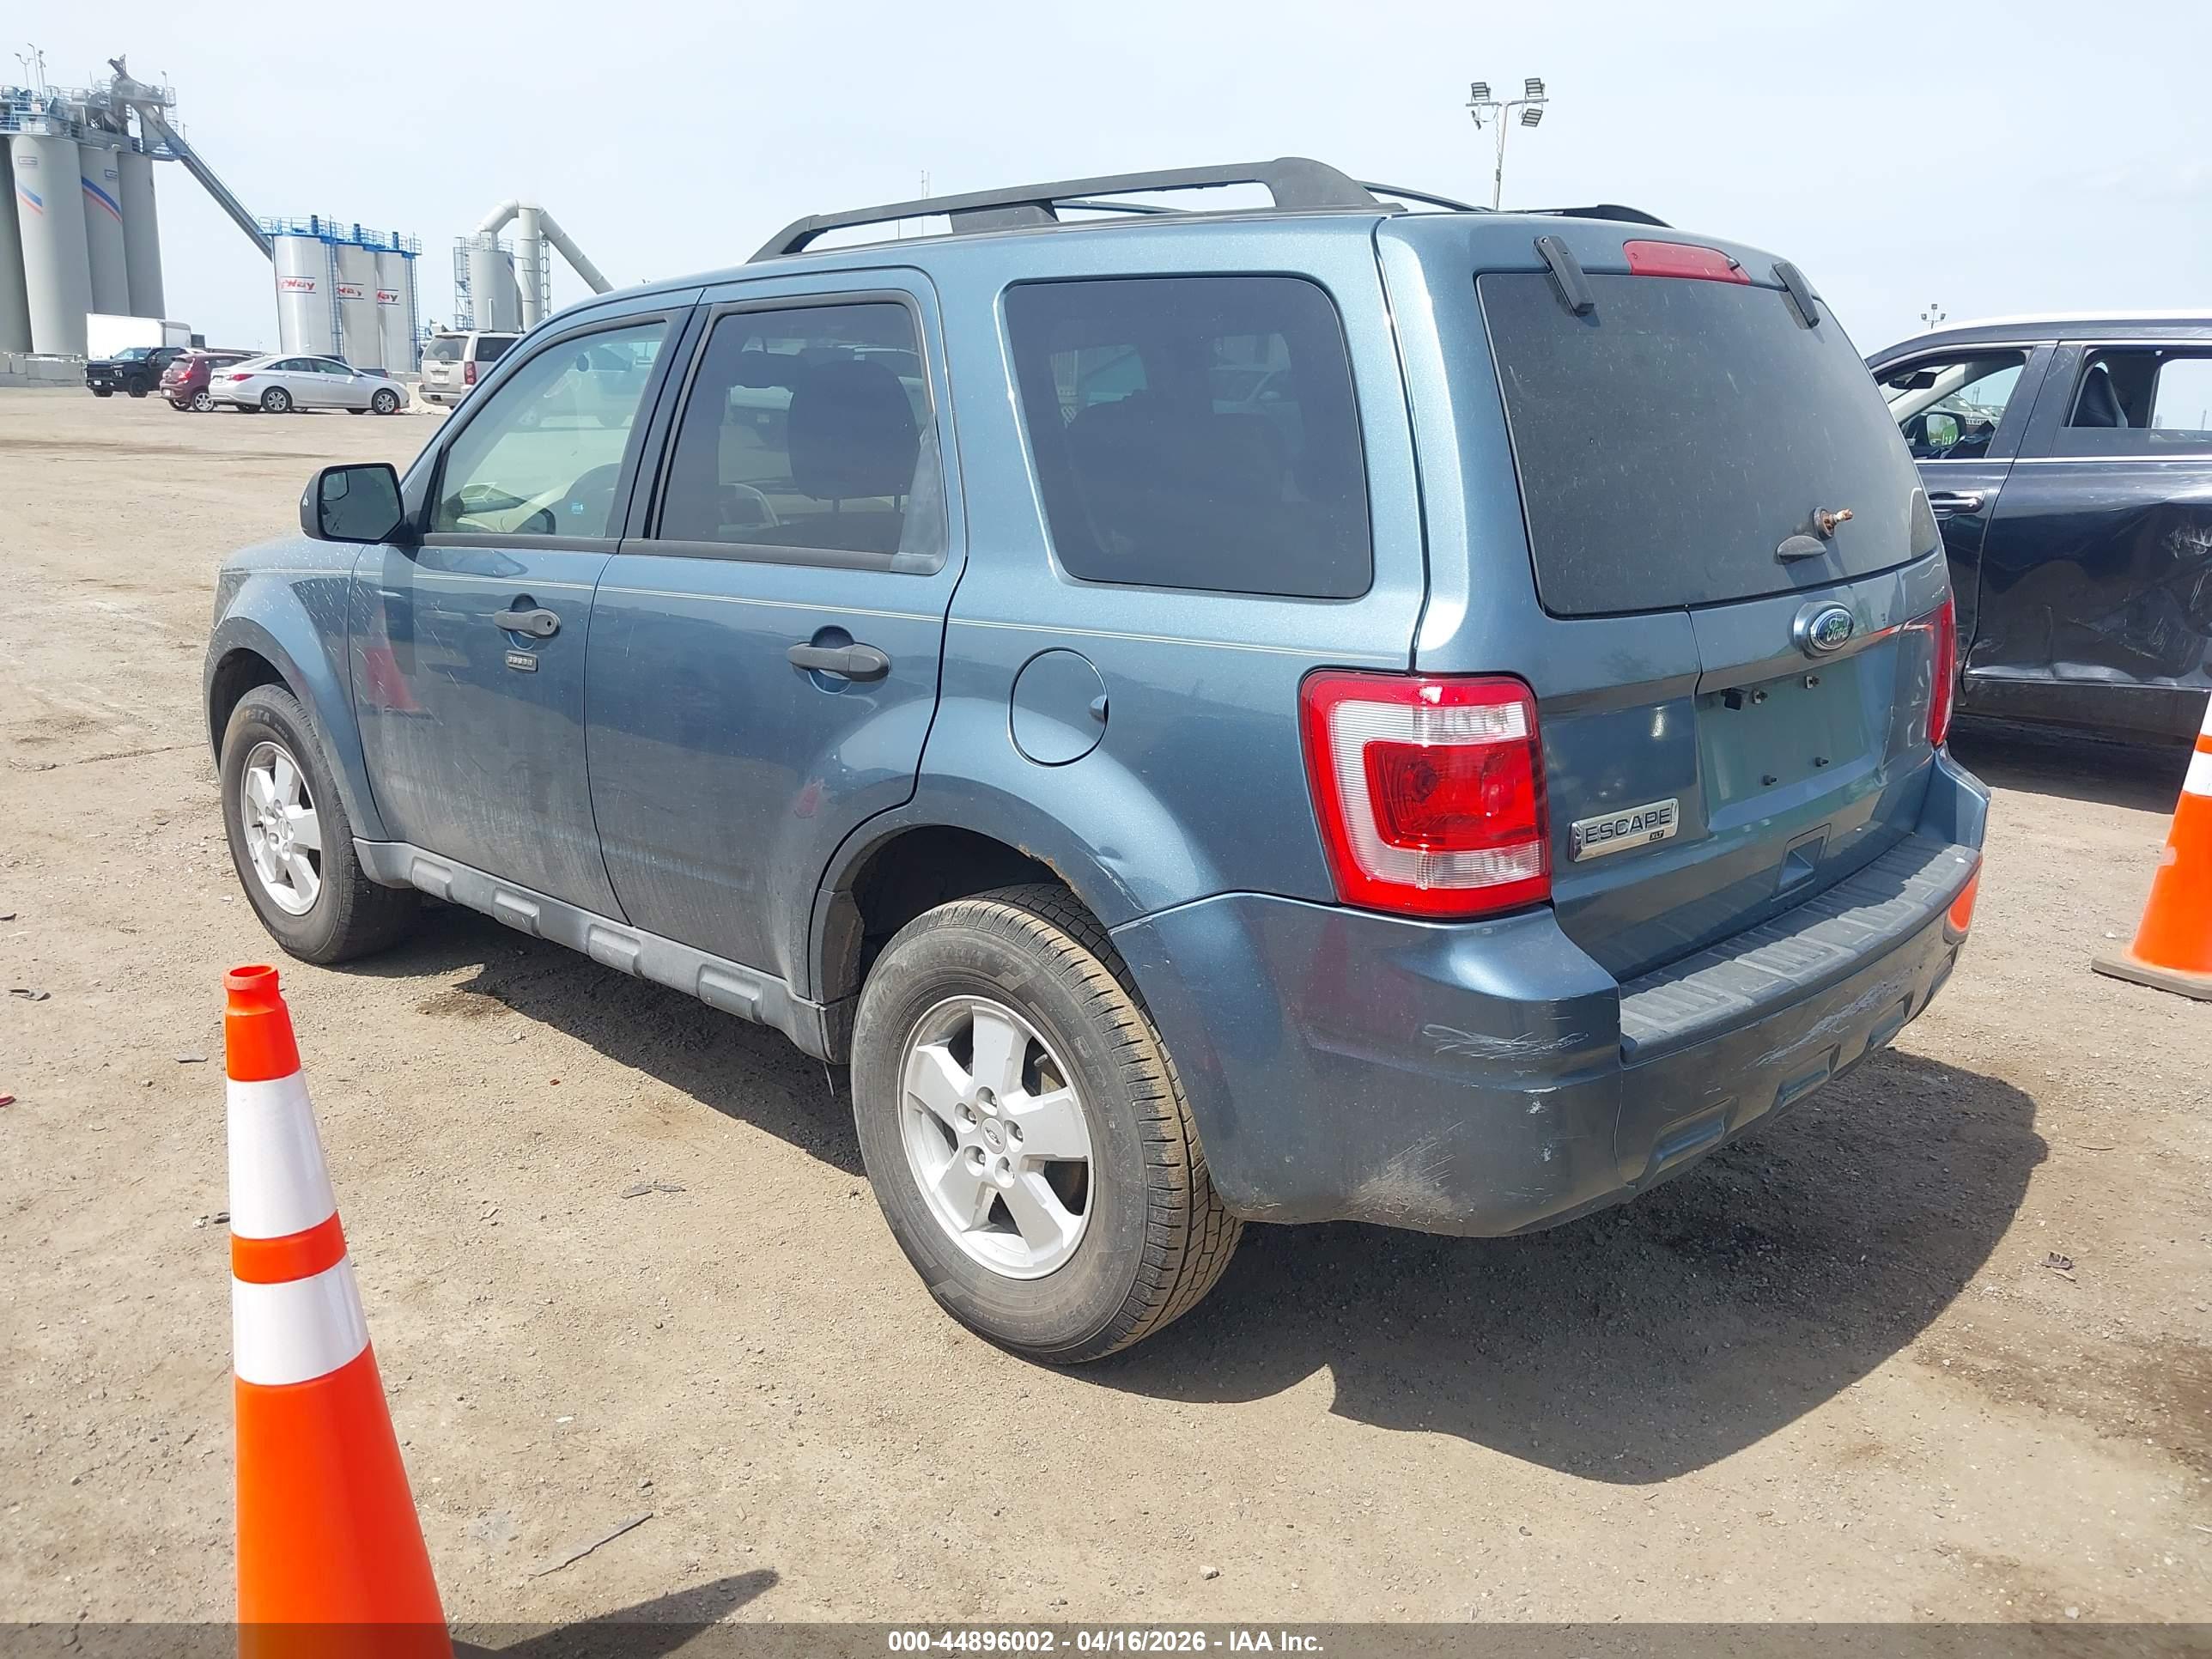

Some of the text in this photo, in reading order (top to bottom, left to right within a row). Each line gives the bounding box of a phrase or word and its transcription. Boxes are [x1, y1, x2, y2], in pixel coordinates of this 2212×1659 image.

[1826, 617, 1850, 642] Ford
[1585, 807, 1671, 844] ESCAPE
[1650, 830, 1664, 840] XLT
